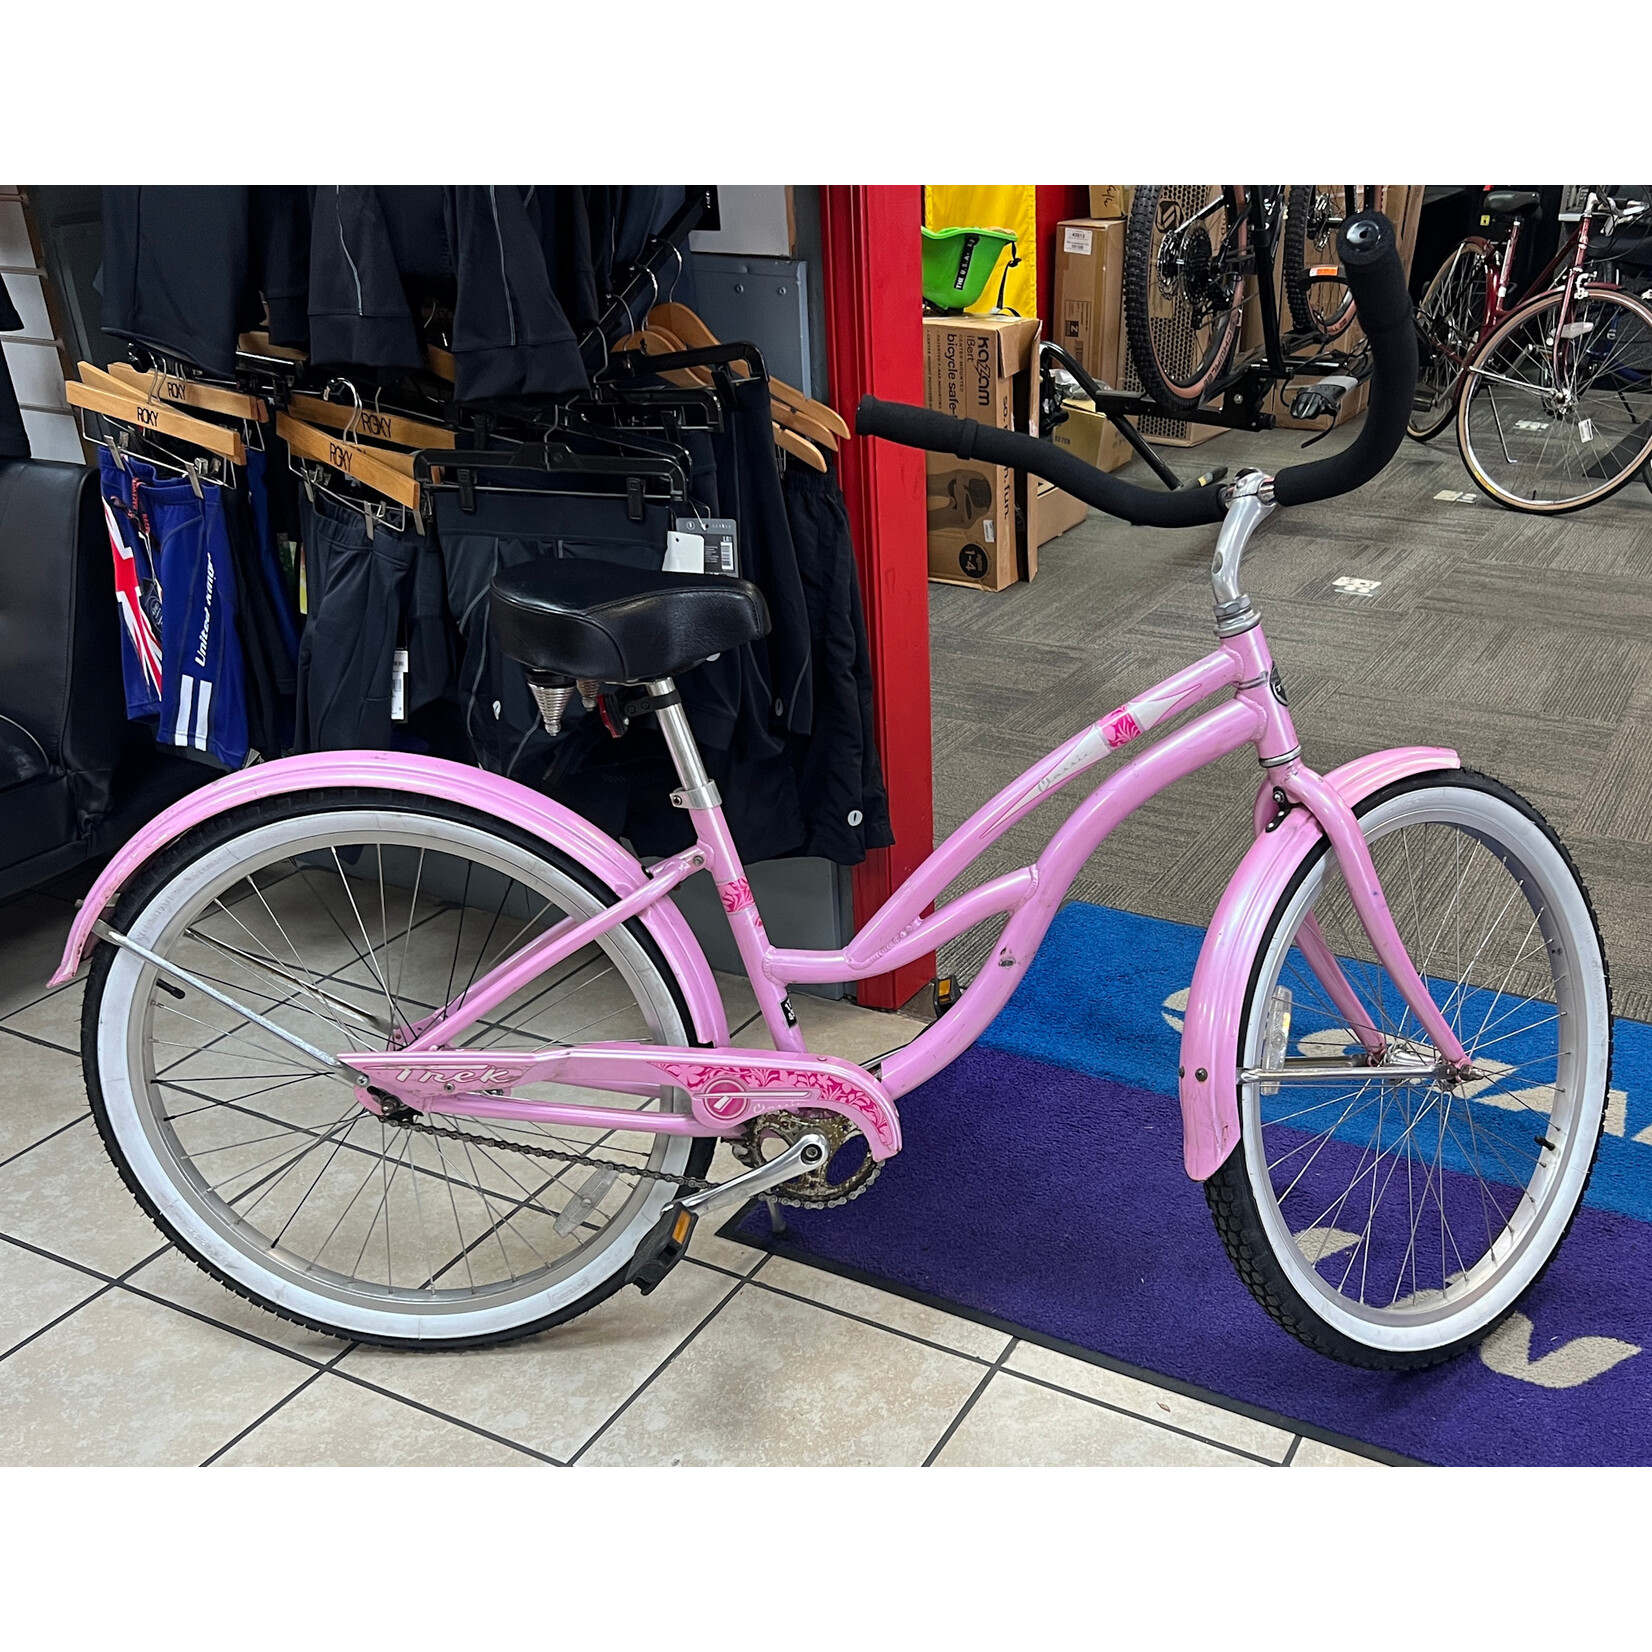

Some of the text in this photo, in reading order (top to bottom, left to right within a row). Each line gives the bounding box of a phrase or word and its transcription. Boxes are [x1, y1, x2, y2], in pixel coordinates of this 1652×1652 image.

[944, 333, 959, 419] bicycle safe-
[167, 382, 186, 400] ROXY
[137, 406, 158, 427] ROXY
[965, 549, 976, 571] 1-4
[195, 606, 211, 668] United
[370, 1064, 512, 1084] Trek
